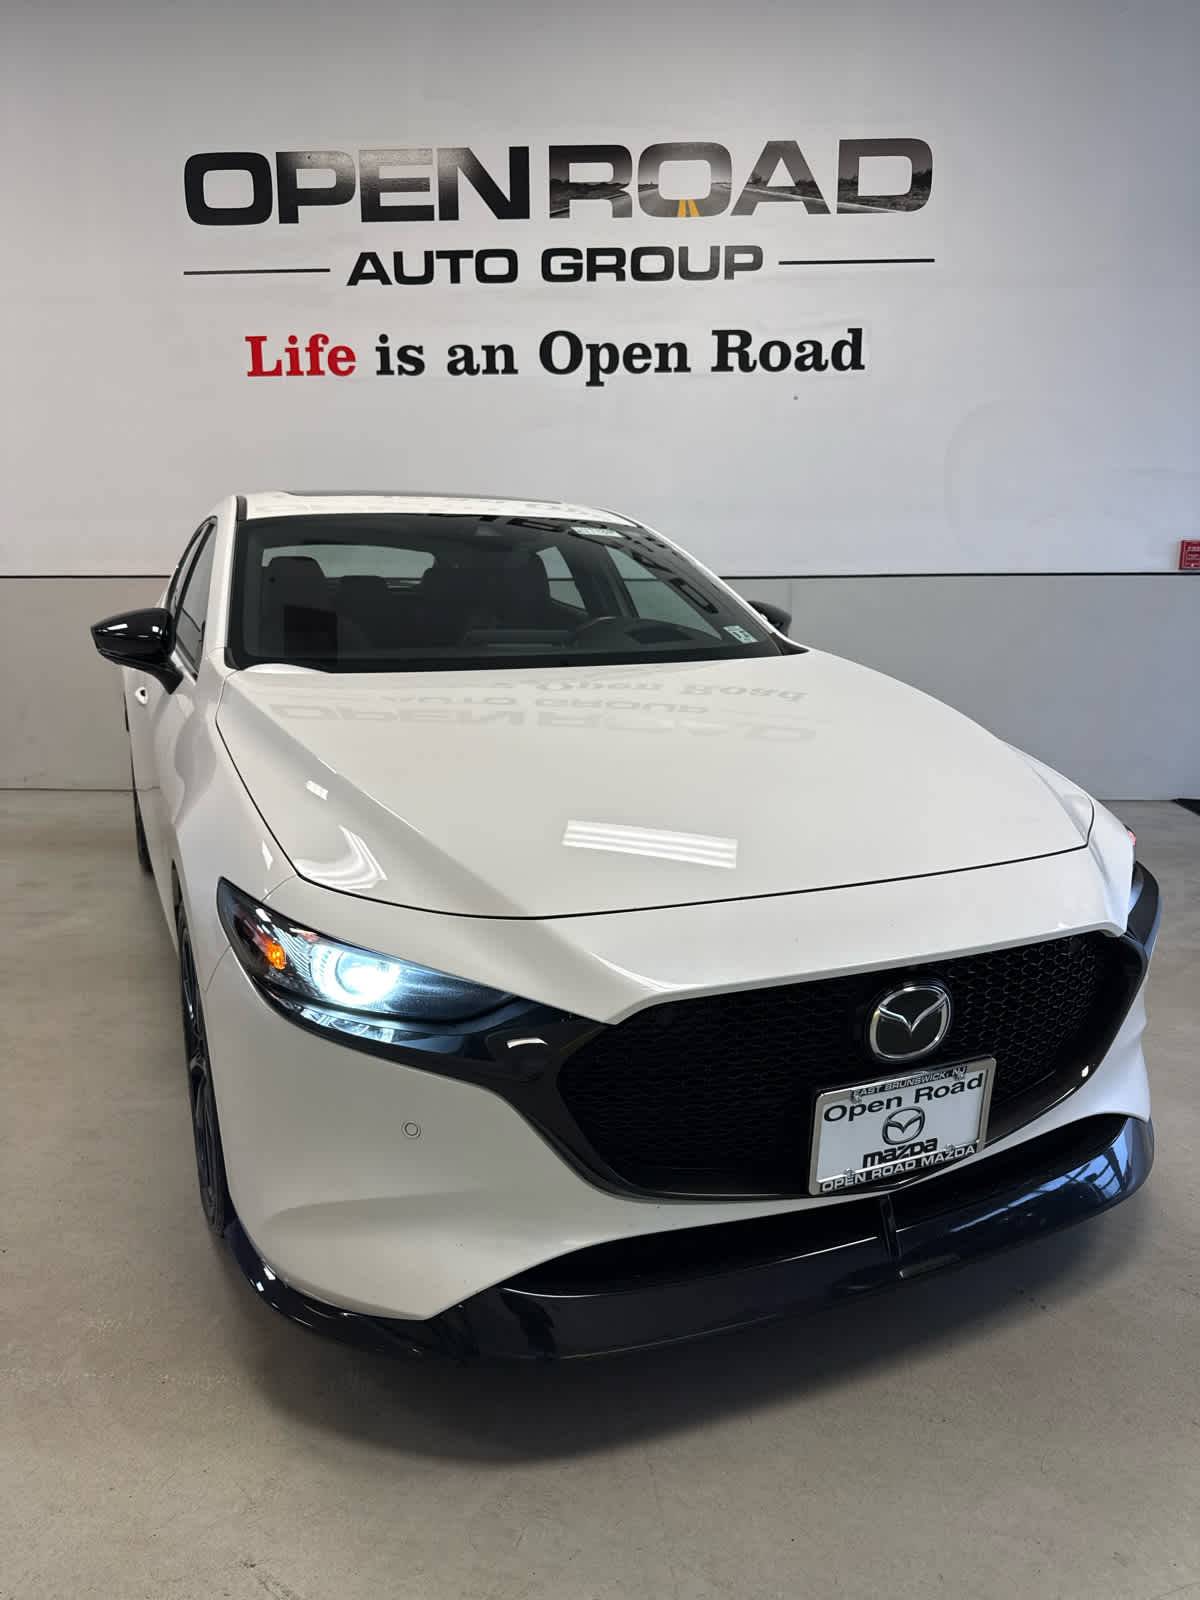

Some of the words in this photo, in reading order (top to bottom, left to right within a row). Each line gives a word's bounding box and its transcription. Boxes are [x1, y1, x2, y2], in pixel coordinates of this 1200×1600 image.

[184, 146, 530, 226] OPEN
[549, 138, 933, 218] ROAD
[347, 249, 518, 286] AUTO
[541, 246, 763, 283] GROUP
[245, 334, 356, 377] Life
[376, 334, 425, 377] is
[447, 344, 518, 377] an
[539, 331, 691, 387] Open
[711, 328, 865, 373] Road
[824, 1096, 903, 1122] Open
[914, 1073, 984, 1103] Road
[822, 1172, 866, 1193] OPEN
[872, 1159, 916, 1179] ROAD
[921, 1144, 976, 1167] MAZDA
[863, 1137, 938, 1168] mazda
